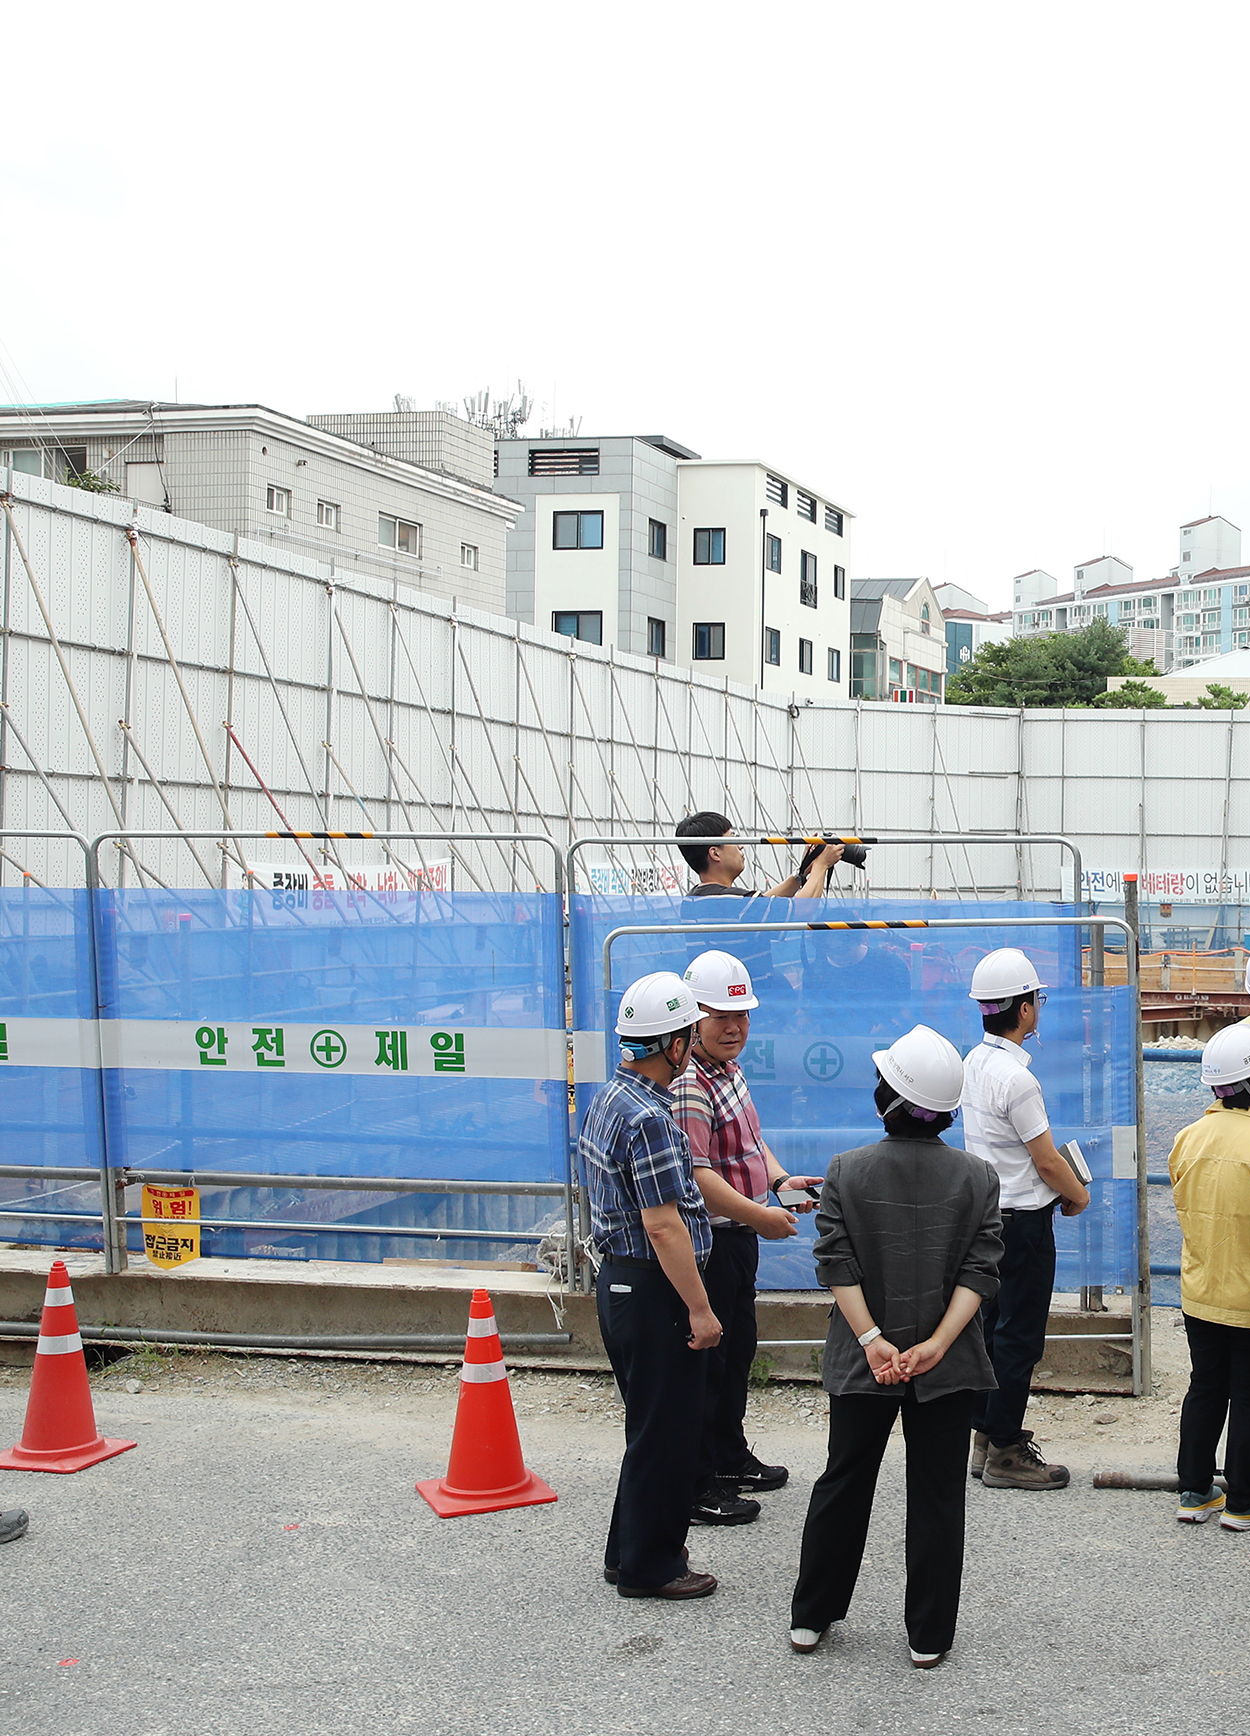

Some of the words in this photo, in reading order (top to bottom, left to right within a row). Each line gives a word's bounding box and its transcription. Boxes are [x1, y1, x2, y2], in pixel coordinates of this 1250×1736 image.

[272, 873, 308, 910] 중장비
[1142, 872, 1199, 895] 베테랑이
[145, 1234, 194, 1252] 접근금지
